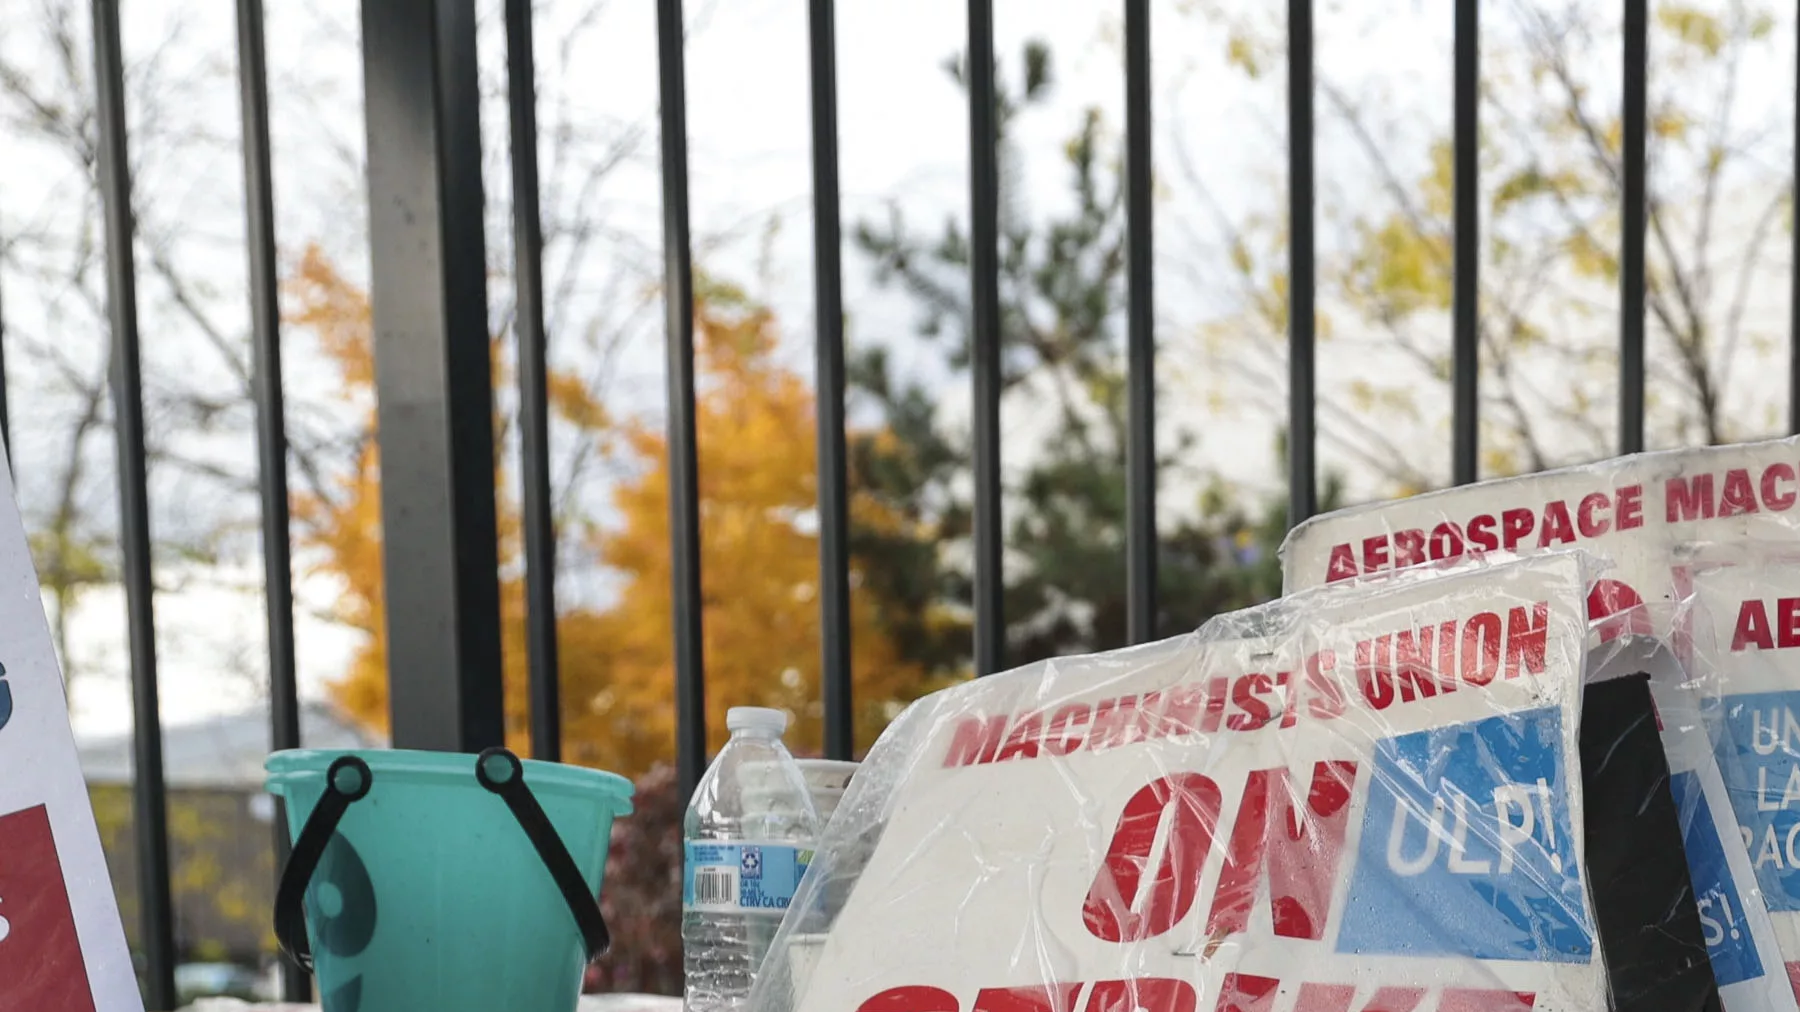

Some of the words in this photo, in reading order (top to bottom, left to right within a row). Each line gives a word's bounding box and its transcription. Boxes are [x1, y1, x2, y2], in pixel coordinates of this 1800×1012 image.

[1325, 484, 1644, 584] AEROSPACE
[943, 651, 1343, 768] MACHINISTS
[1357, 601, 1549, 711] UNION
[1083, 760, 1359, 943] ON
[1387, 776, 1563, 878] ULP!
